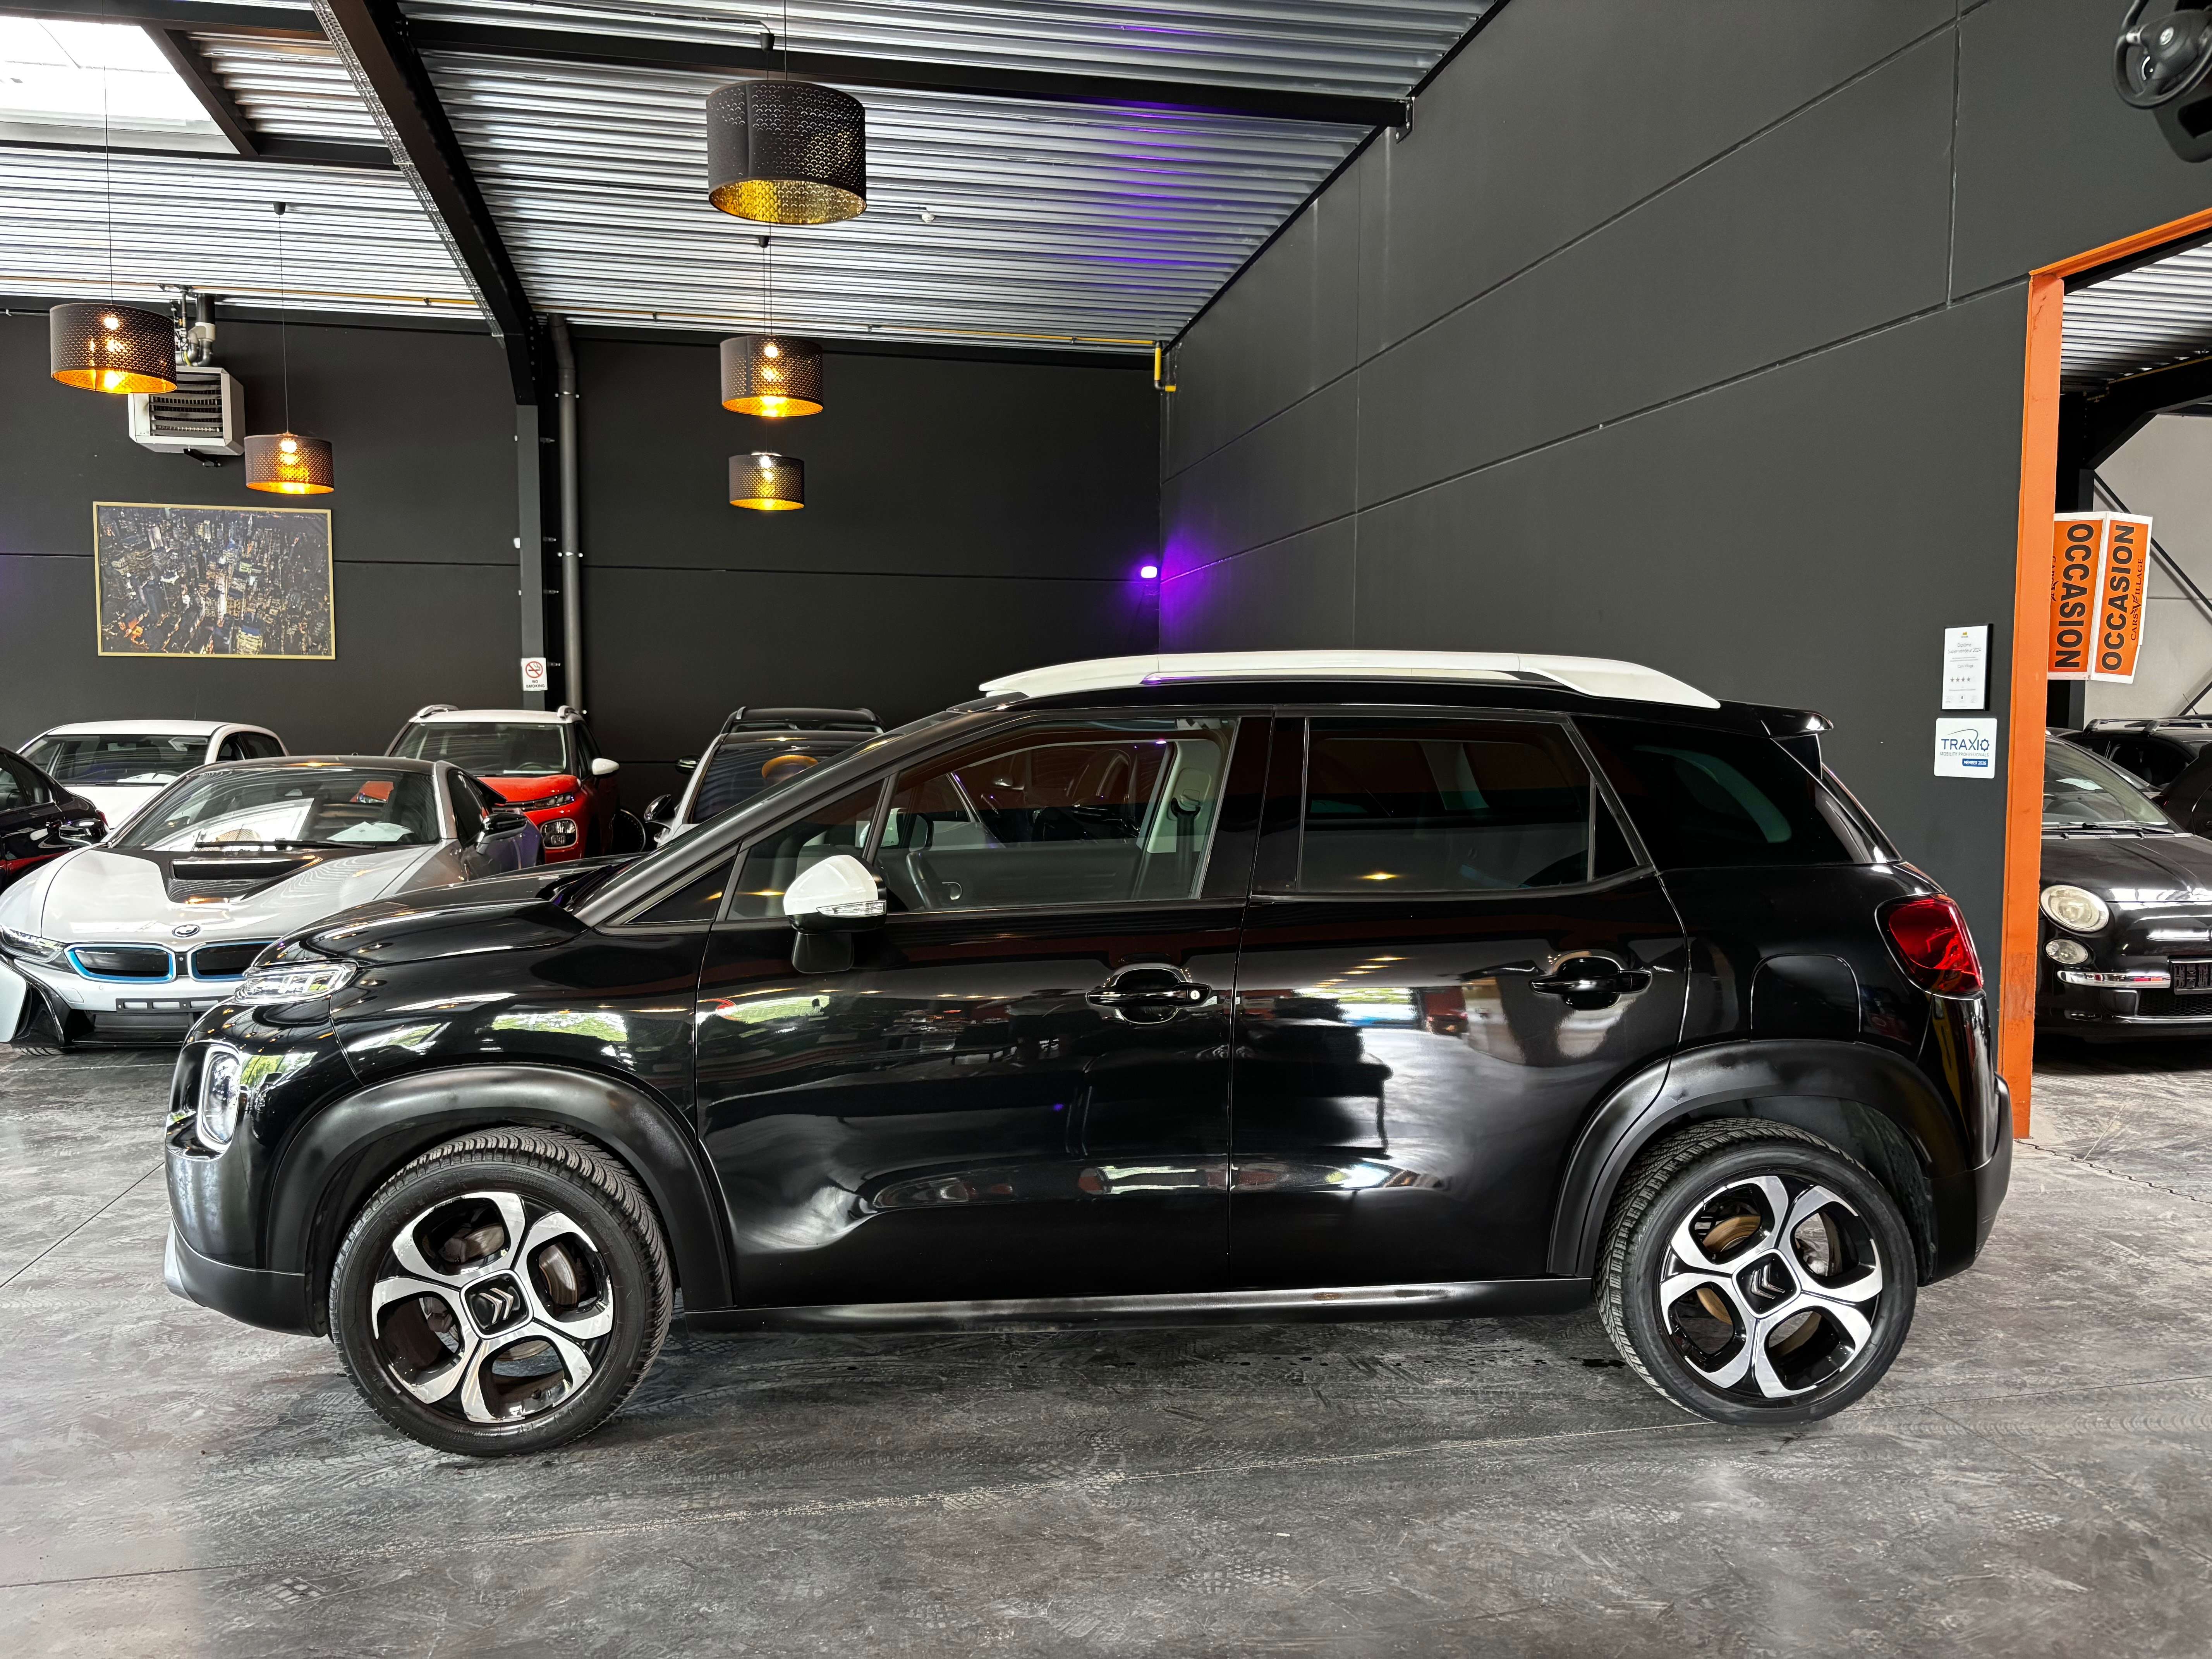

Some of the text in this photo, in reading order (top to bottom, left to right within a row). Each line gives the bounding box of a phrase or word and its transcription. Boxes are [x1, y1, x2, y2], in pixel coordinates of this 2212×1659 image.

[2054, 524, 2094, 668] OCCASION
[2102, 525, 2135, 670] OCCASION
[1941, 738, 1990, 752] TRAXIO
